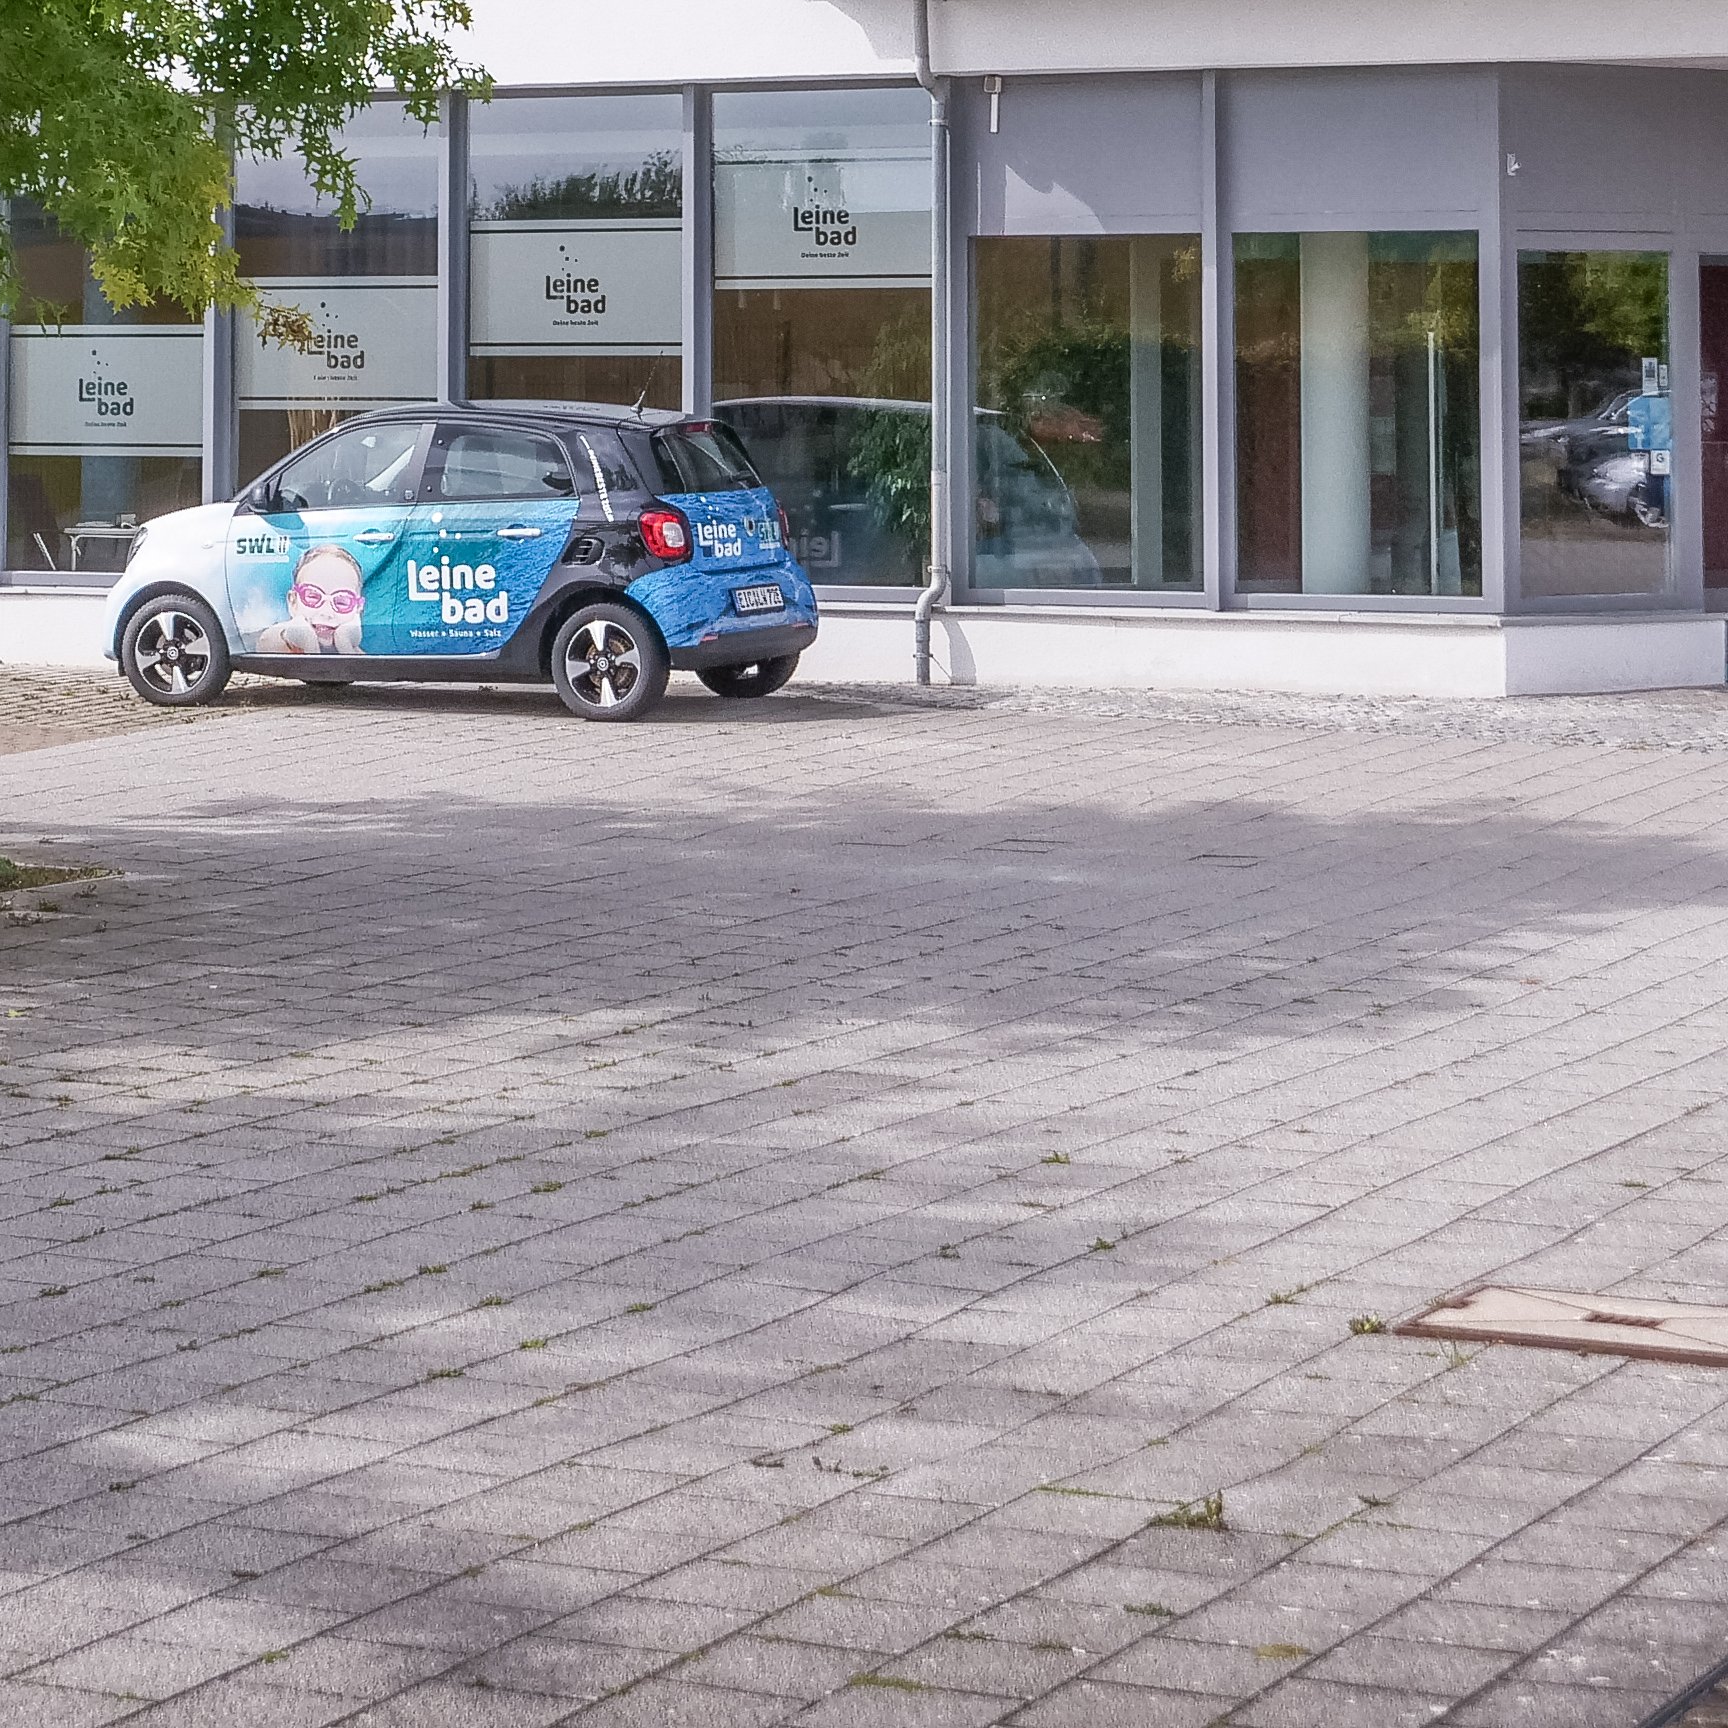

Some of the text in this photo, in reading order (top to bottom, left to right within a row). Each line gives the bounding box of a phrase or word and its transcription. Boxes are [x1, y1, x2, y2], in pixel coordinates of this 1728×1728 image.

[793, 204, 849, 231] Leine
[815, 226, 856, 246] bad
[546, 272, 599, 300] Leine
[566, 294, 606, 314] bad
[307, 329, 358, 355] Leine
[327, 350, 365, 369] bad
[79, 376, 128, 402] Leine
[97, 397, 134, 416] bad
[236, 533, 275, 554] SWL
[697, 520, 736, 546] Leine
[714, 538, 741, 558] bad
[407, 556, 496, 601] Leine
[441, 590, 509, 624] bad
[410, 630, 438, 638] Wasser
[449, 629, 473, 638] Sauna
